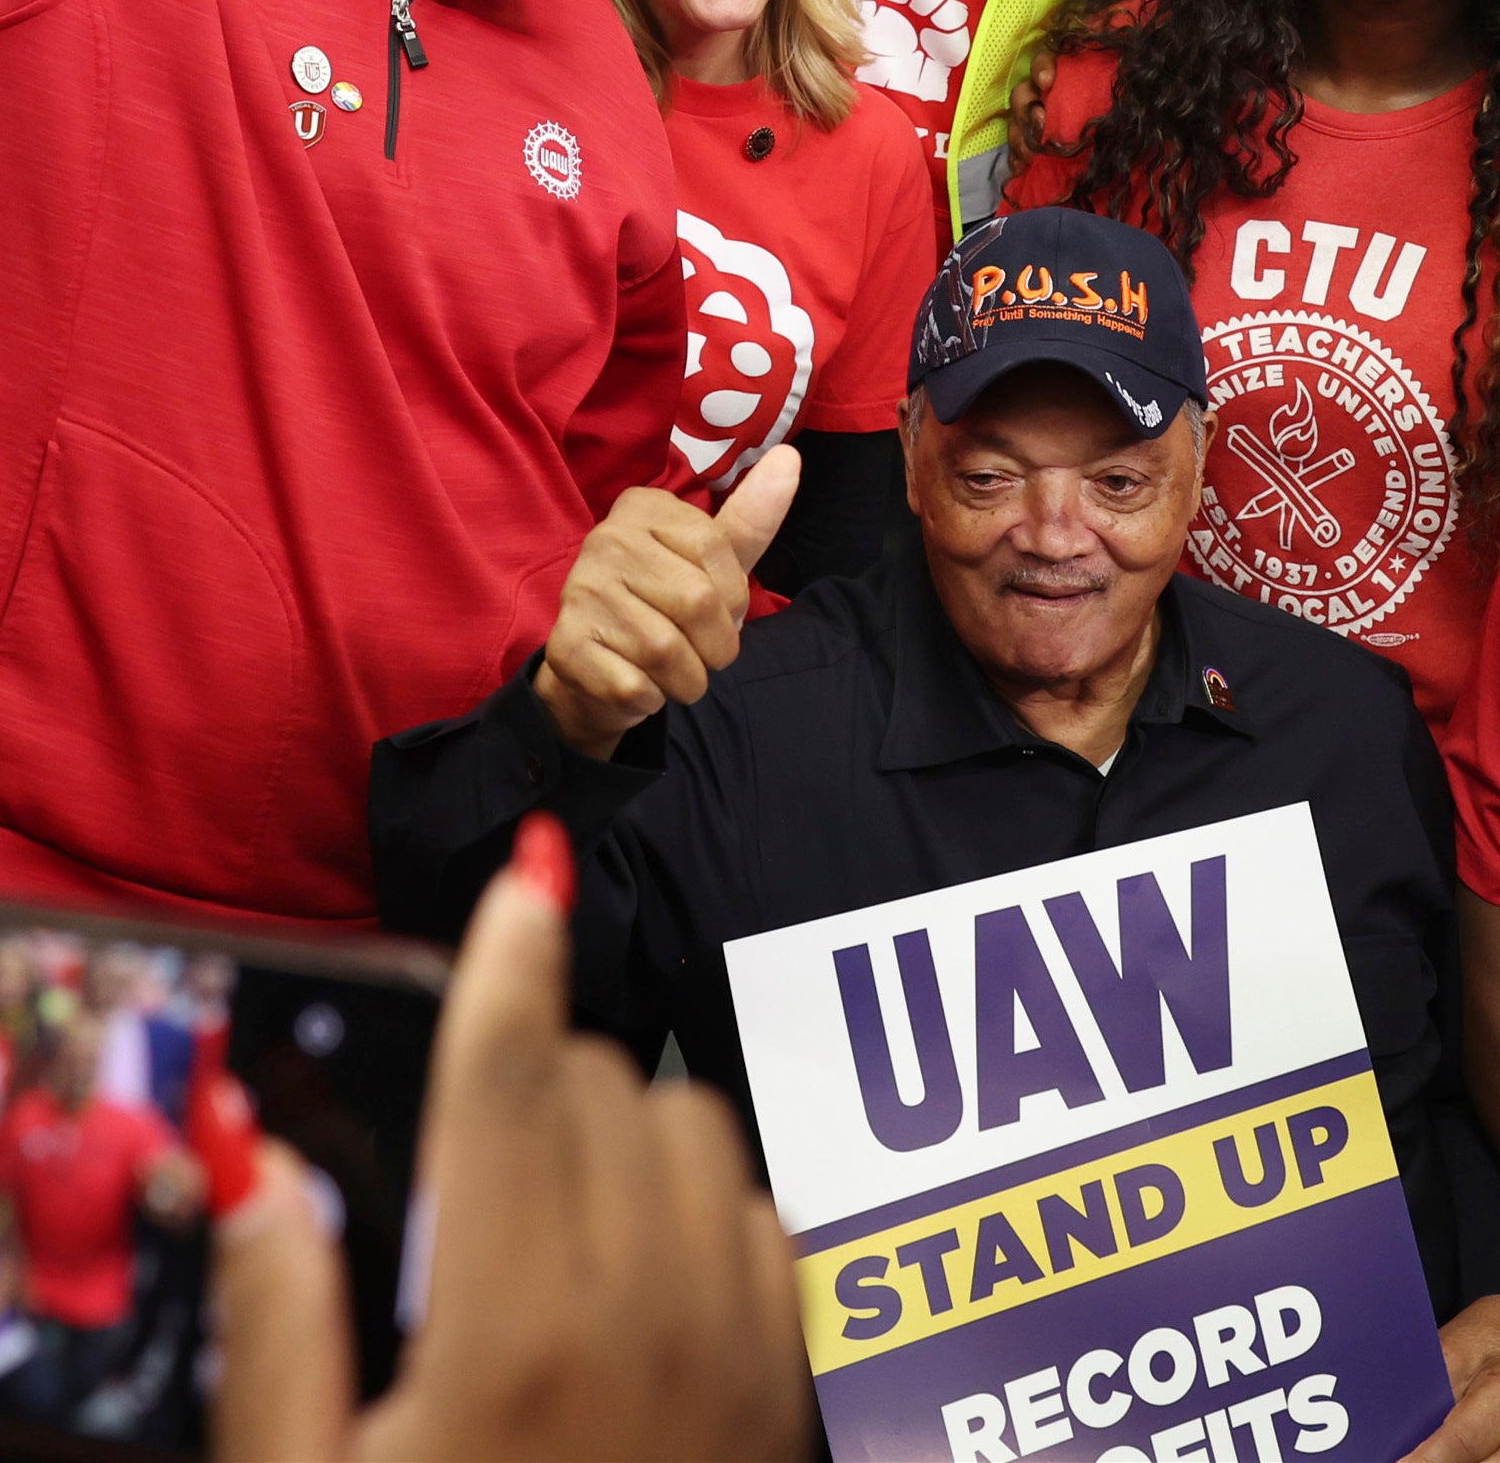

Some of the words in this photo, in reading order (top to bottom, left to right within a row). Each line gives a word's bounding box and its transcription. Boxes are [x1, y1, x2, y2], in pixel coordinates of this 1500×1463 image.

[540, 147, 568, 176] UAW
[972, 315, 996, 330] Pray
[1000, 308, 1024, 321] Until
[1028, 308, 1093, 325] Something
[1230, 219, 1428, 322] CTU
[1219, 325, 1423, 432] TEACHERS
[1396, 442, 1446, 558] UNION
[1317, 372, 1398, 458] UNITE
[1192, 528, 1253, 590] AFT
[1371, 568, 1397, 592] 1
[1202, 485, 1242, 553] EST.
[1254, 549, 1318, 586] 1937
[1334, 468, 1407, 580] DEFEND
[832, 854, 1233, 1154] UAW
[833, 1163, 1187, 1341] STAND
[1212, 1105, 1350, 1209] UP
[940, 1284, 1323, 1463] RECORD
